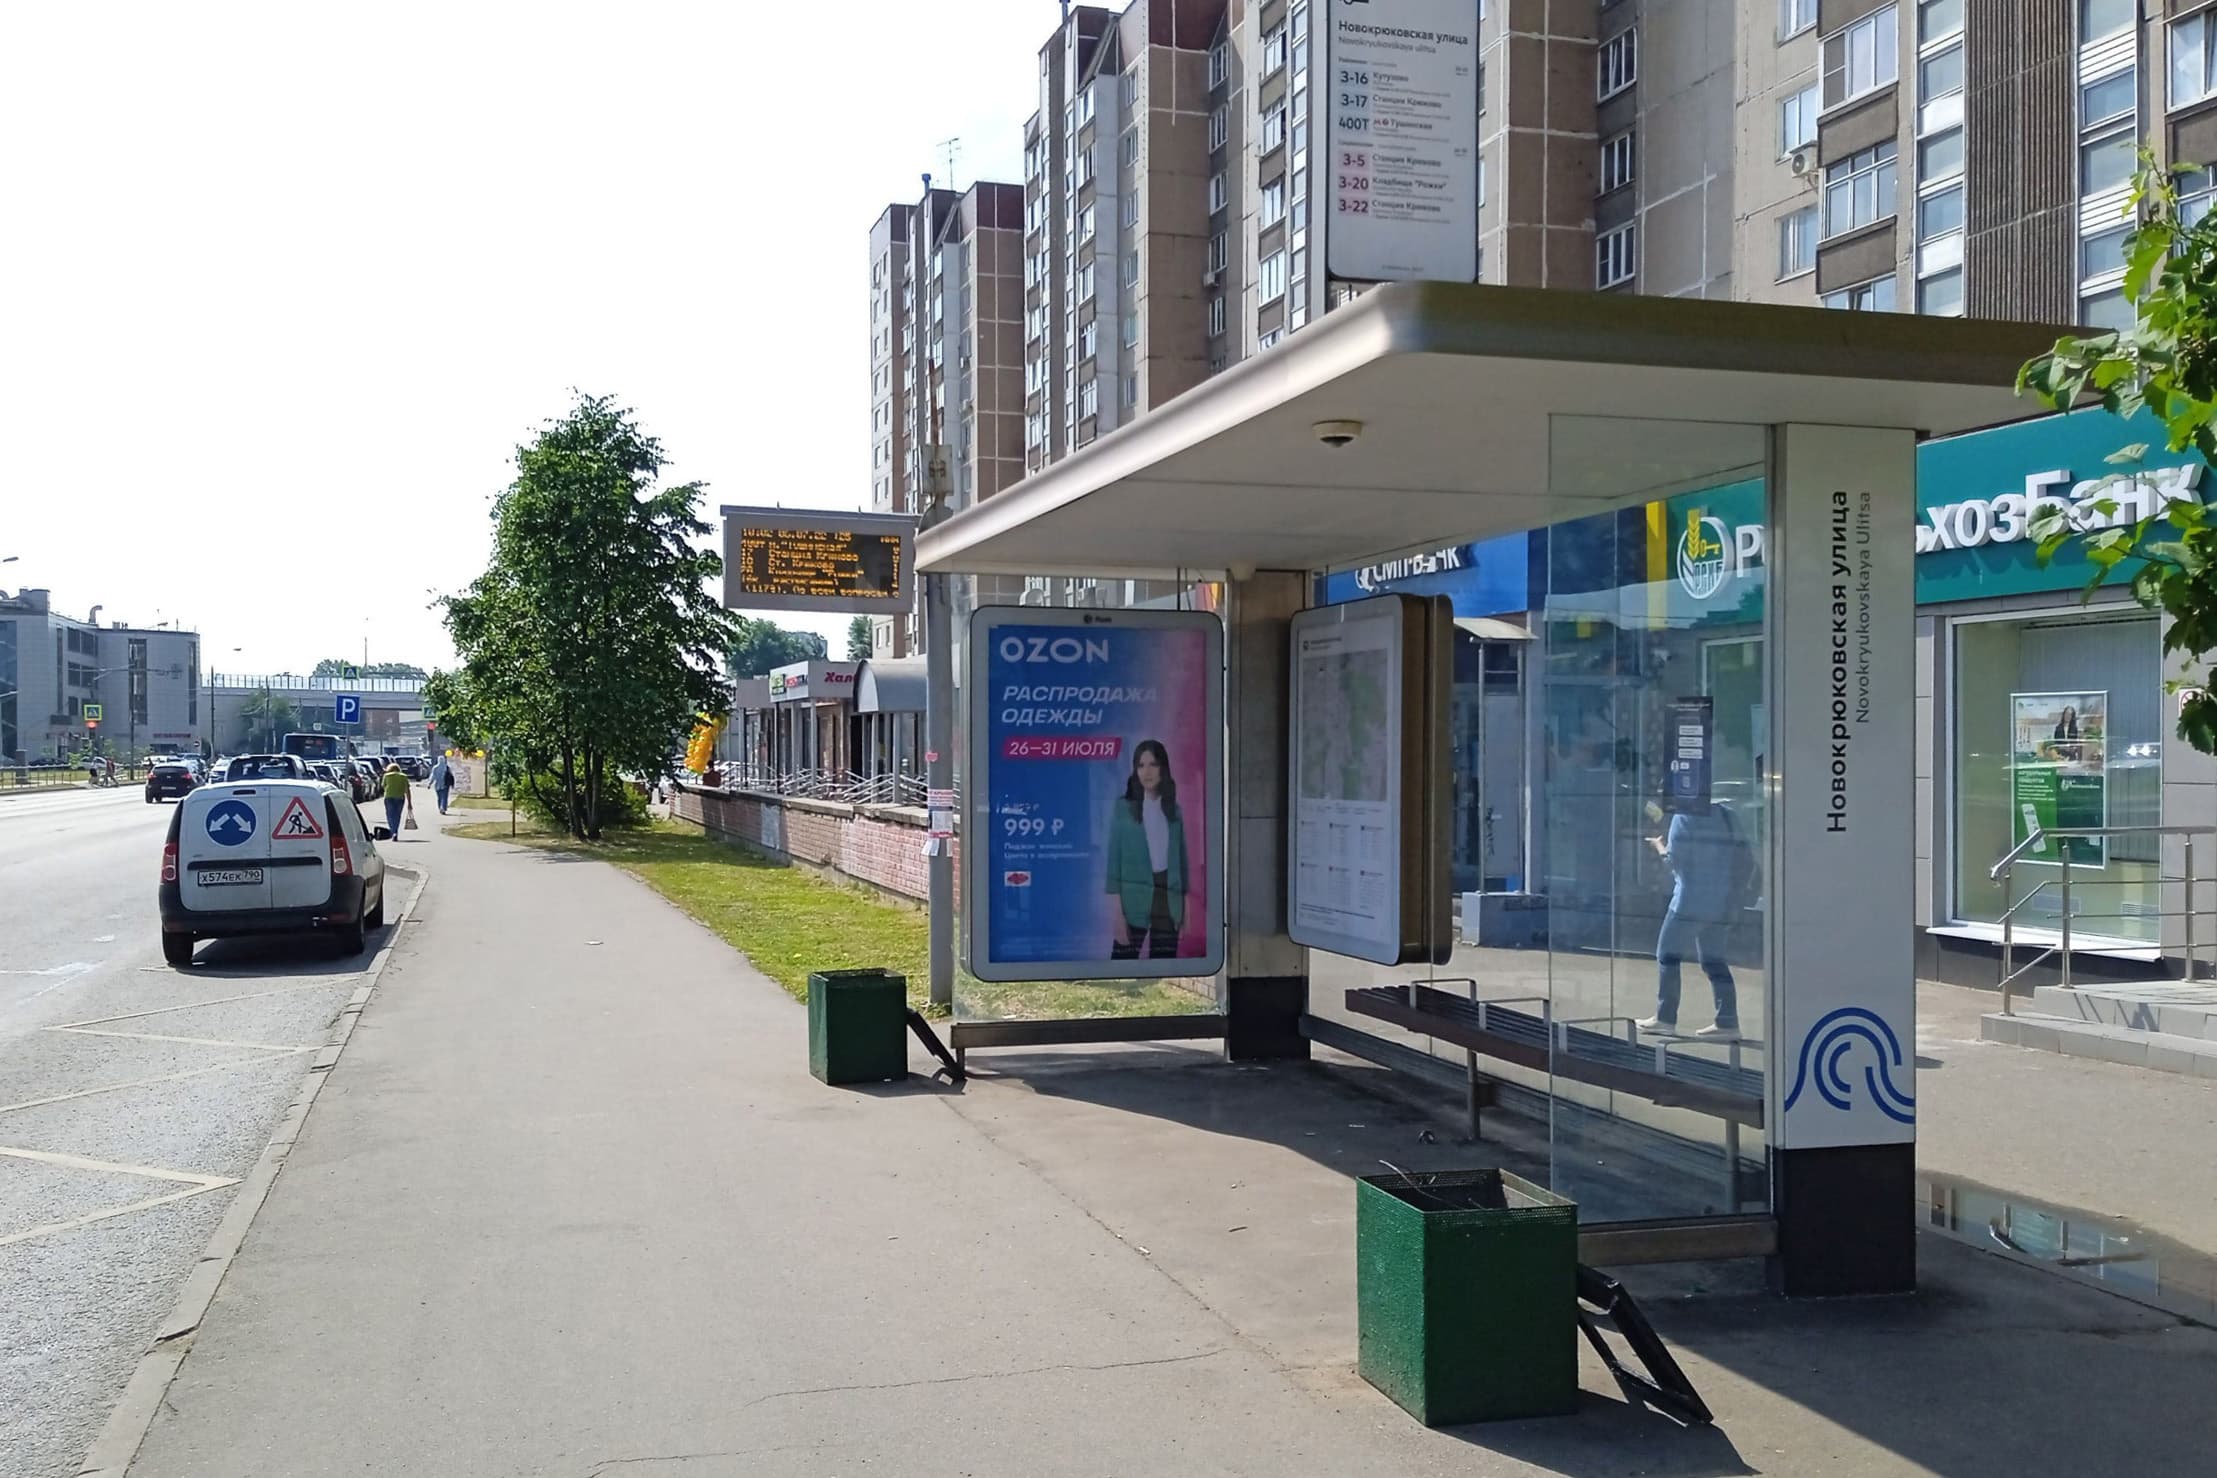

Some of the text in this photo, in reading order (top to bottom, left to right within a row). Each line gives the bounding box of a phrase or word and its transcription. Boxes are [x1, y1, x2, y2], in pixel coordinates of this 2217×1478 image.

[1338, 20, 1469, 45] Новокрюковская улица
[1856, 492, 1872, 723] Novokryukovskaya Ulitsa
[1000, 636, 1109, 664] OZON
[1827, 491, 1852, 832] Новокрюковская улица
[1003, 685, 1159, 704] РАСПРОДАЖА
[1001, 707, 1104, 727] ОДЕЖДЫ
[1062, 741, 1116, 756] ИЮЛЯ
[1004, 818, 1045, 836] 999
